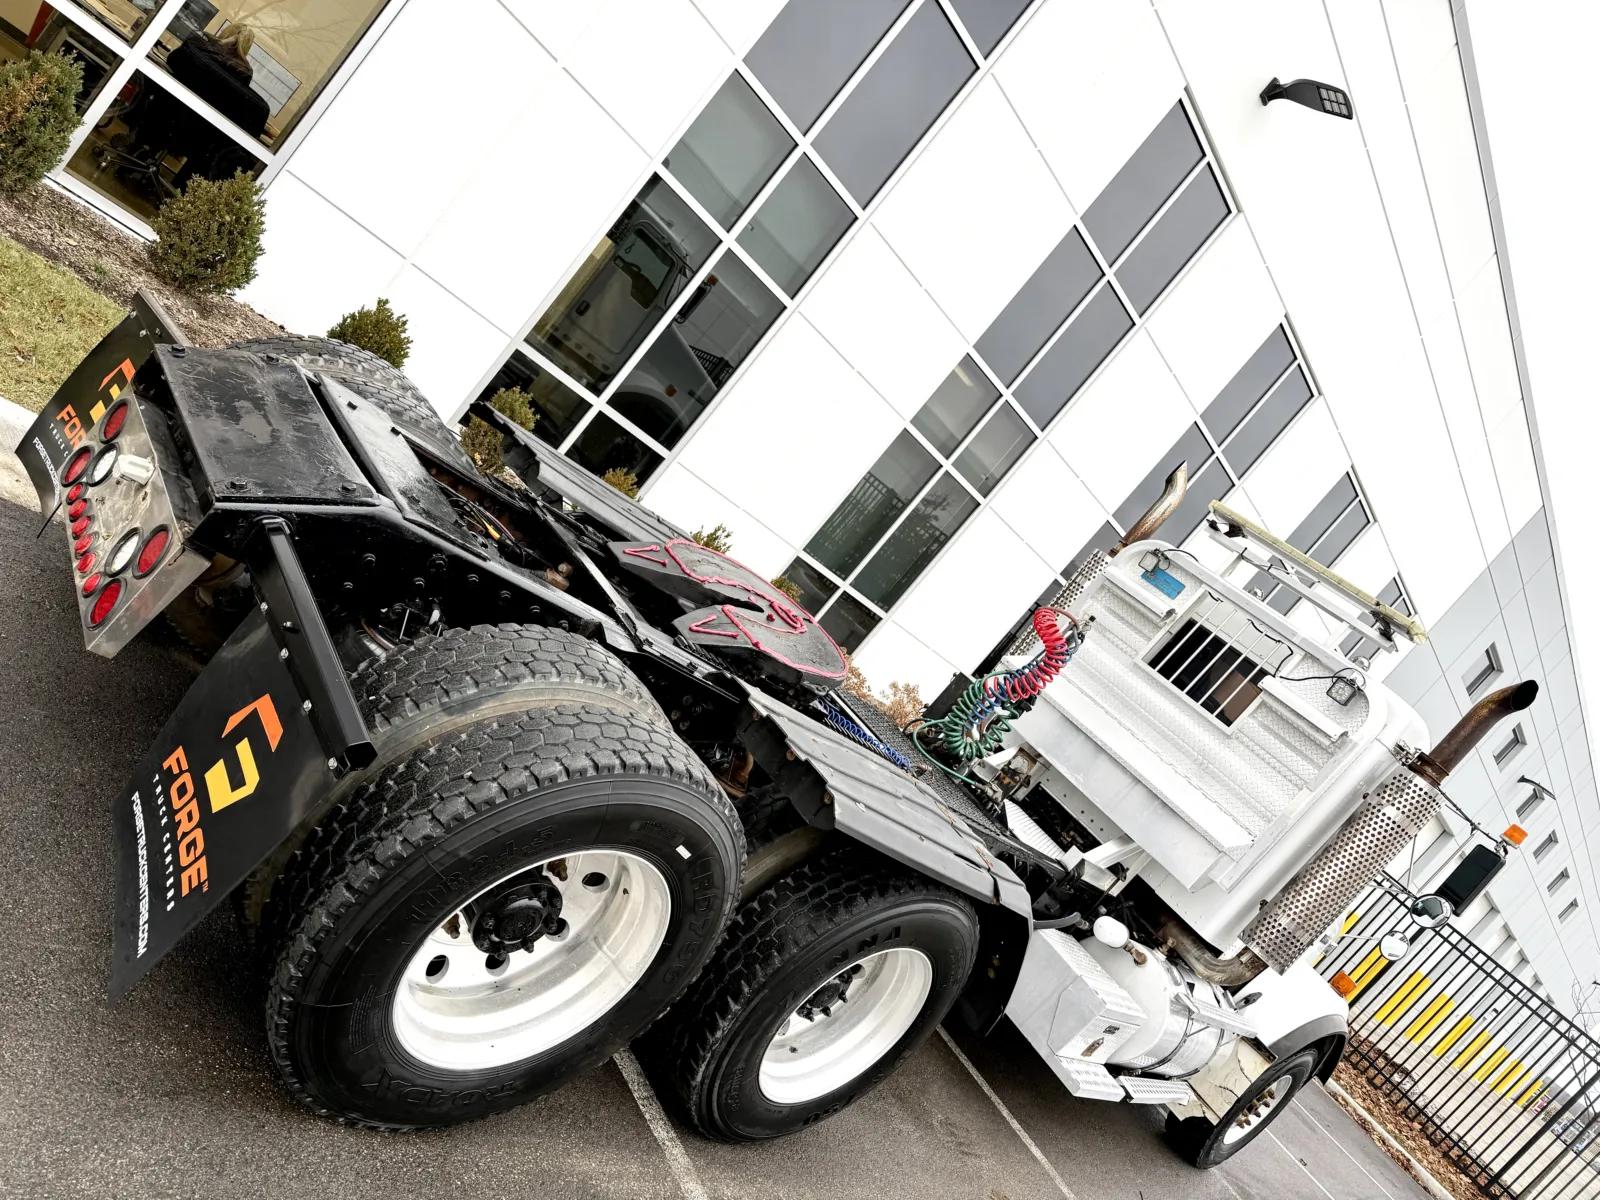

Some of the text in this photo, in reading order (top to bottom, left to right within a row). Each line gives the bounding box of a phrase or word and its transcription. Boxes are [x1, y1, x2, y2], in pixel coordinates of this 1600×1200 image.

[55, 403, 87, 451] FOR
[131, 790, 149, 959] FORGETRUCKCENTERS.COM
[153, 773, 175, 912] TRUCK CENTERS
[162, 745, 208, 898] FORGE
